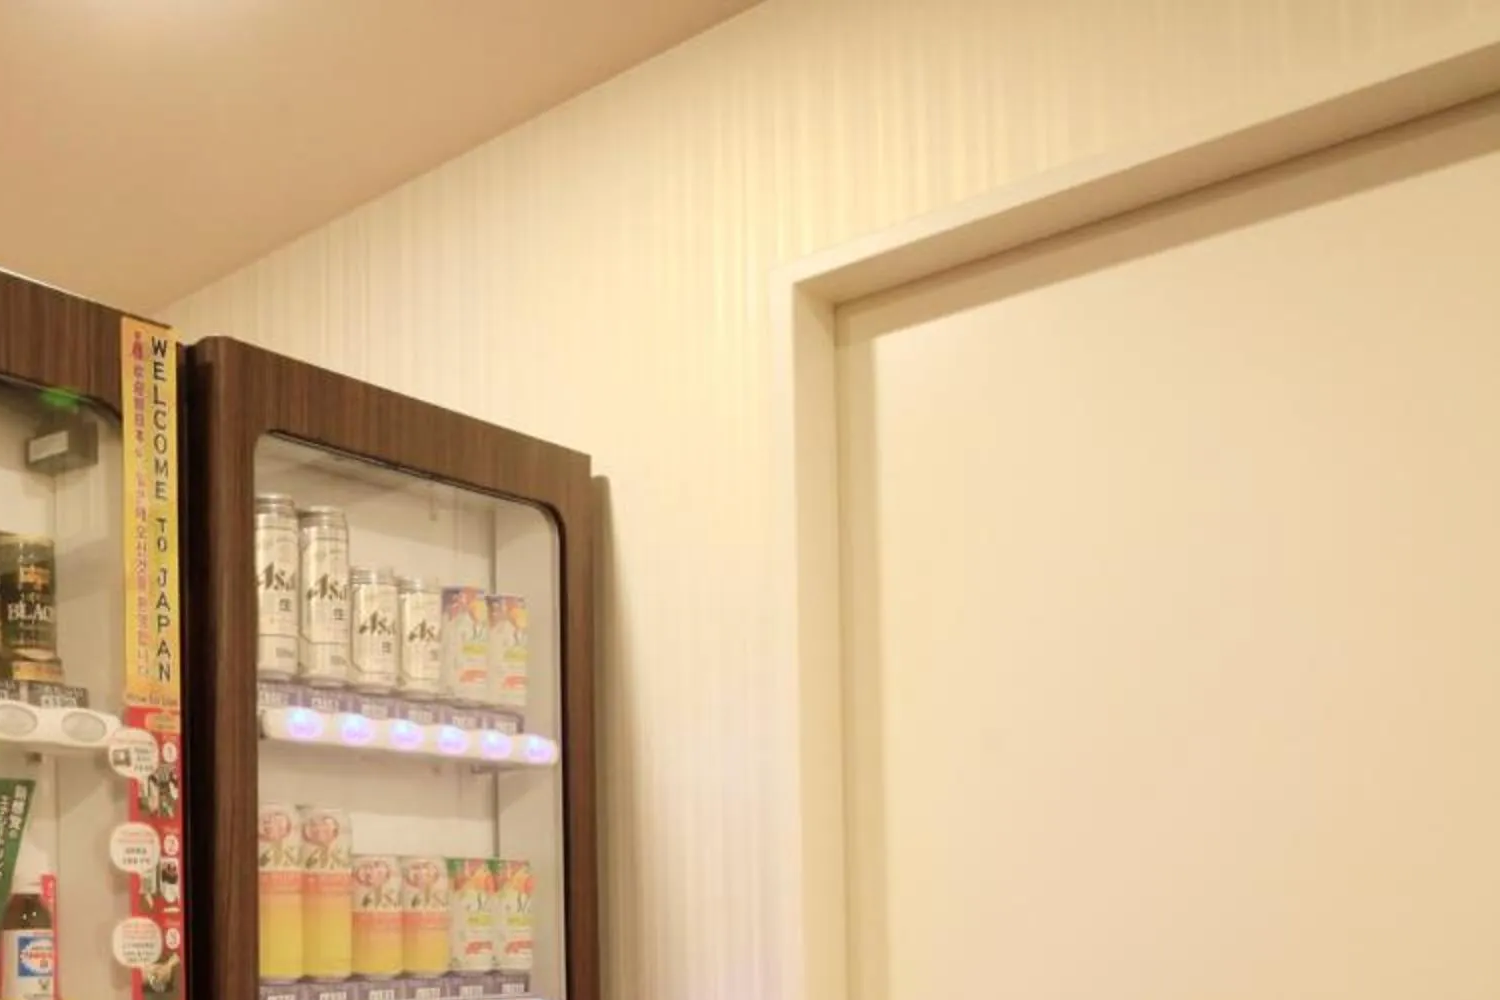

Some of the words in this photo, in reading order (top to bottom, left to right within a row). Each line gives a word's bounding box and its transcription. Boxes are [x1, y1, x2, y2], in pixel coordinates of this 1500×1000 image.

[151, 335, 169, 501] WELCOME
[155, 517, 168, 553] TO
[155, 567, 172, 683] JAPAN
